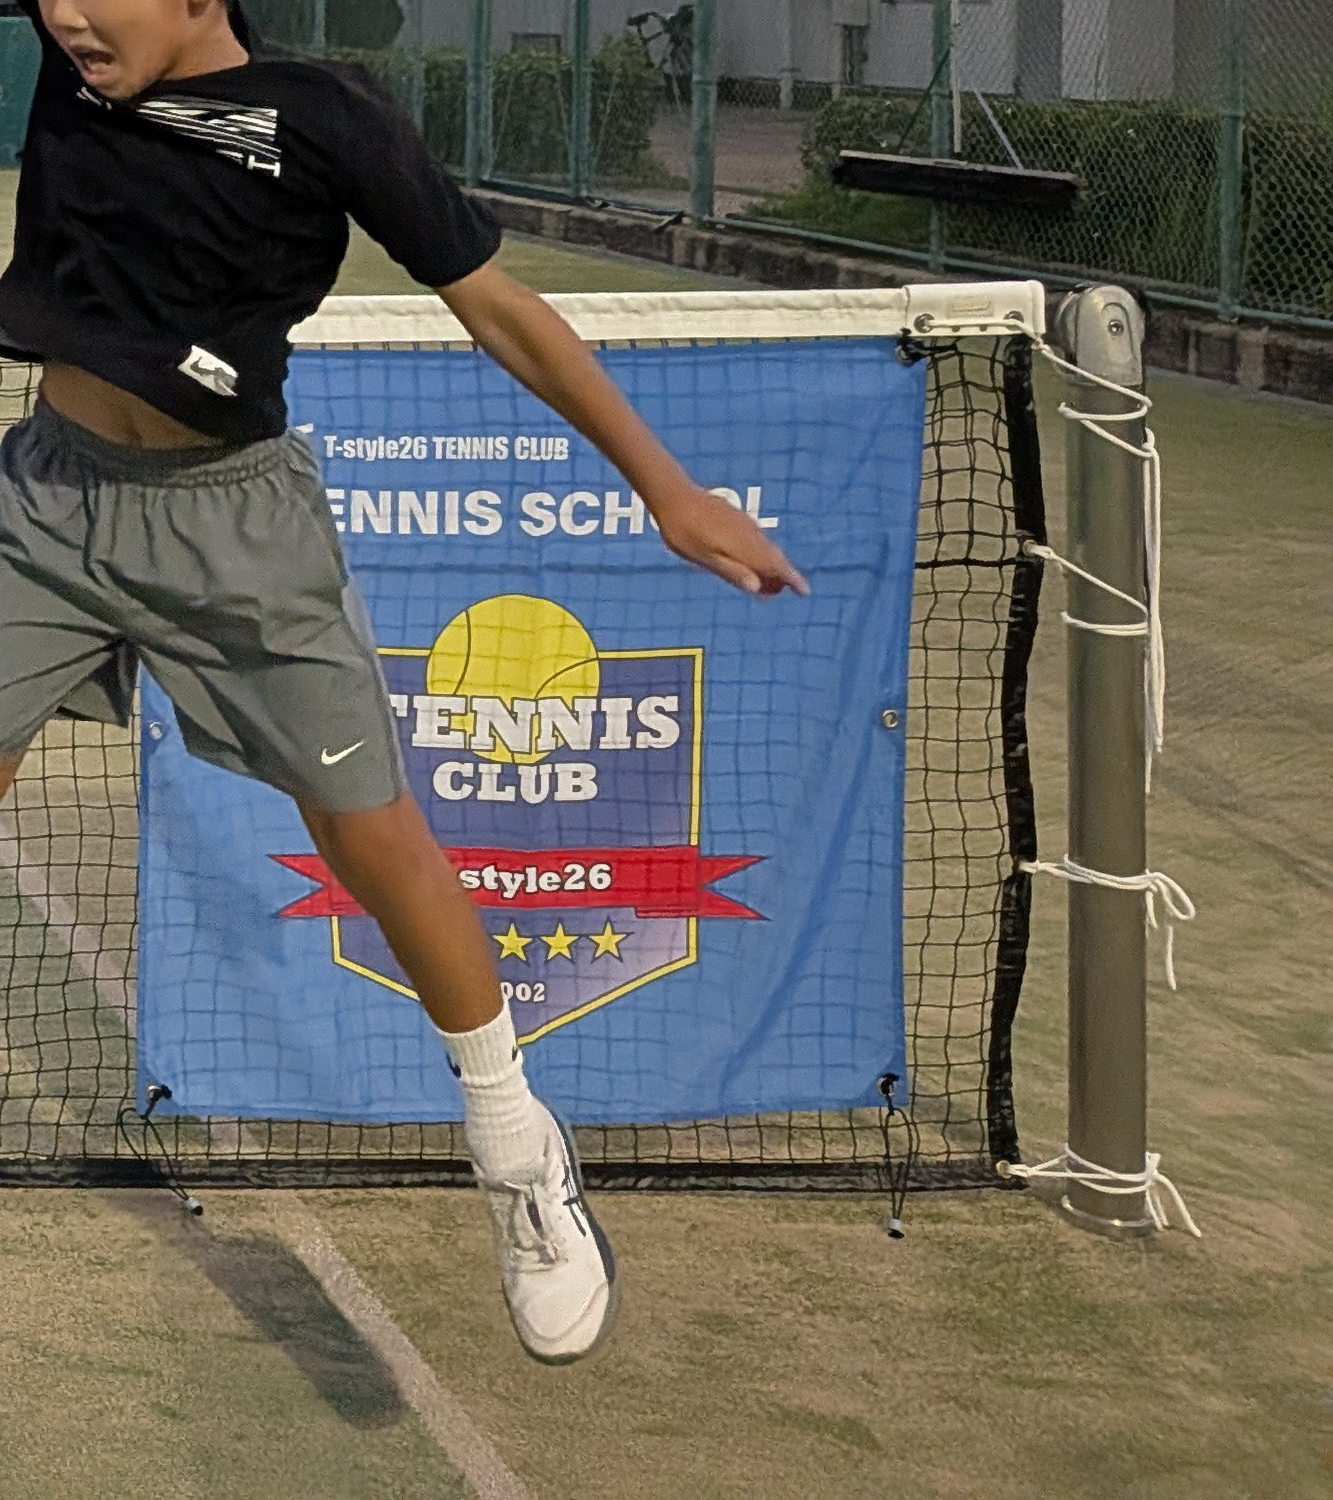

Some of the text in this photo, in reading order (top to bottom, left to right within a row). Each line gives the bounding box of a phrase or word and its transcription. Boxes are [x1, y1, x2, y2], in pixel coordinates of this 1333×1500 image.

[323, 435, 569, 462] T-style26 TENNIS CLUB
[325, 485, 779, 537] ENNIS SCHL
[432, 760, 599, 804] CLUB
[458, 863, 613, 899] style26
